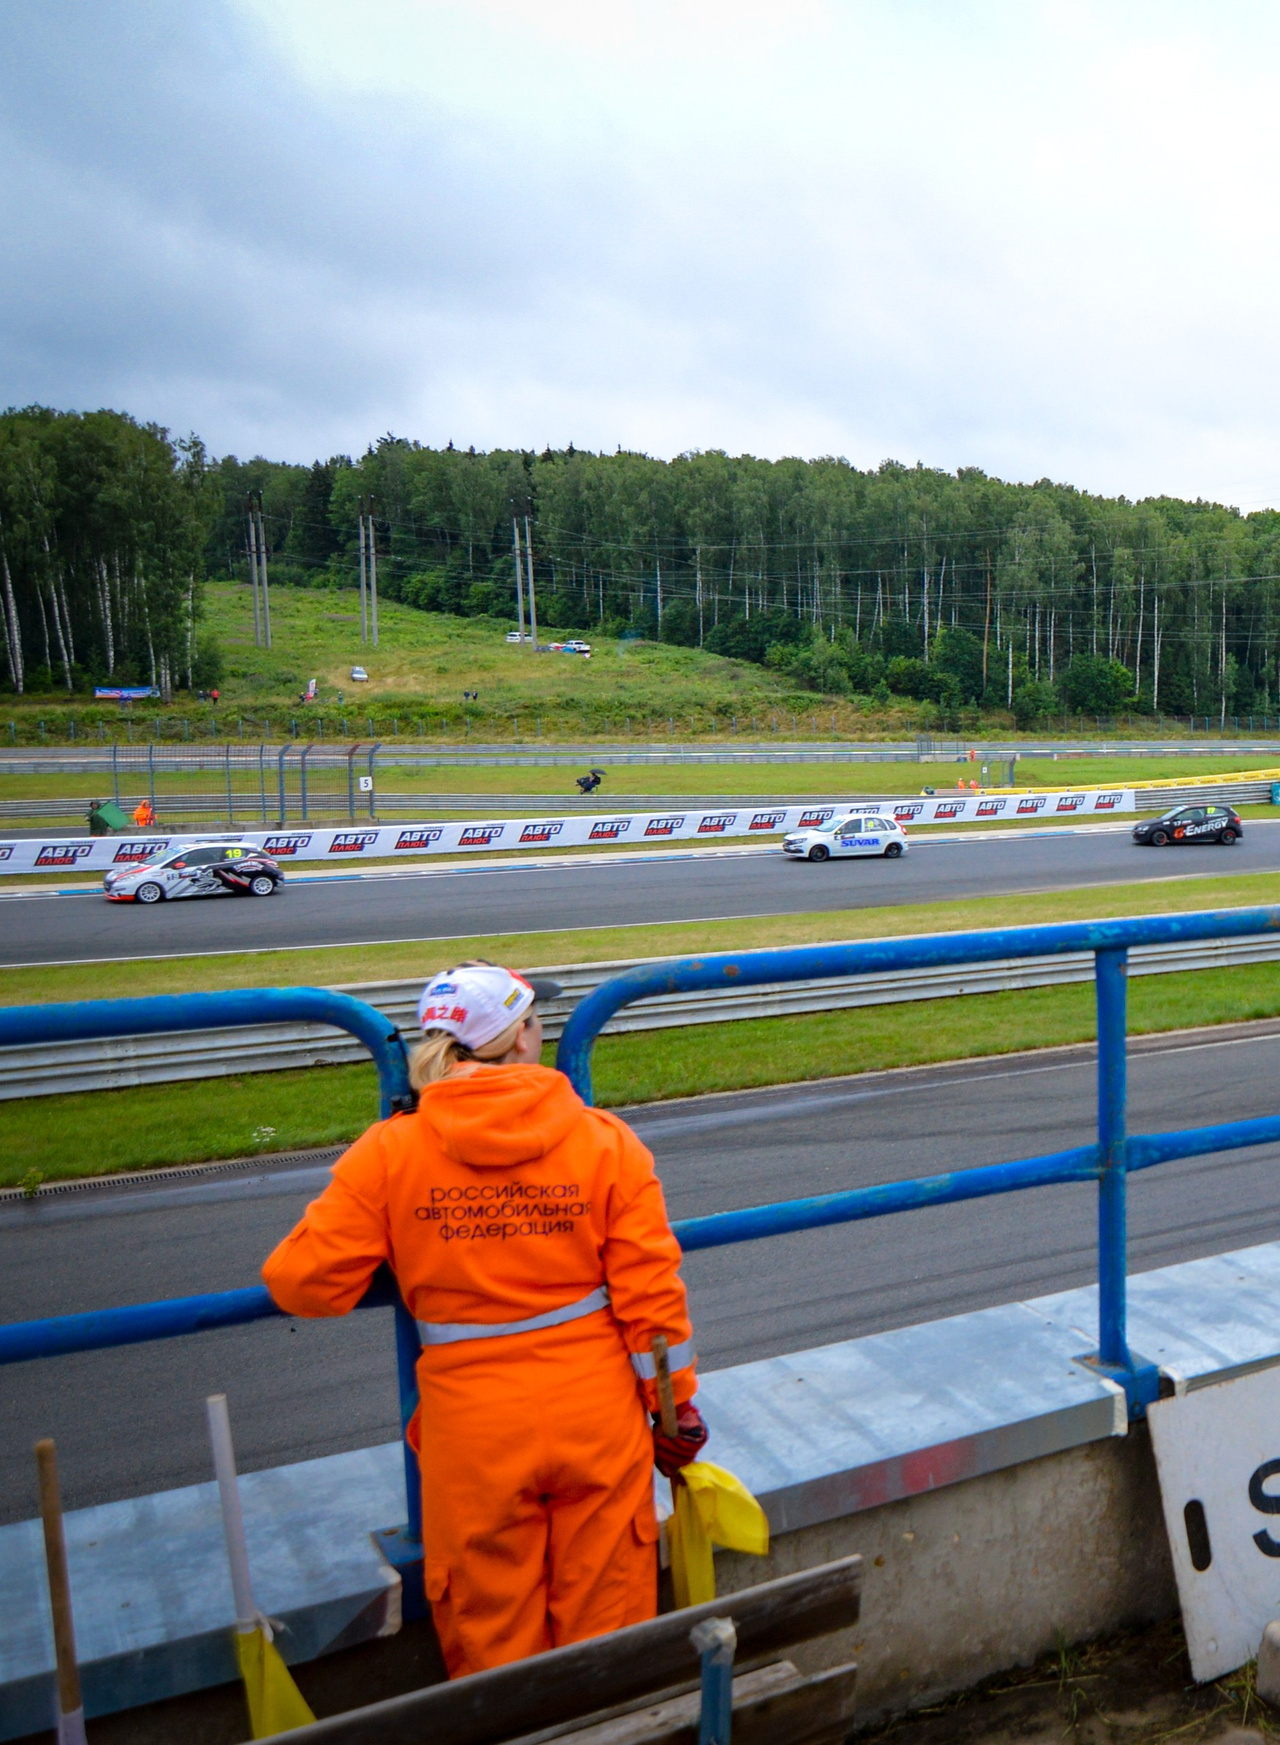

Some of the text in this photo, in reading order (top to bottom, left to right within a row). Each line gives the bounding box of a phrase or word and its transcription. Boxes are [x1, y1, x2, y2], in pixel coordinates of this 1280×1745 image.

[363, 779, 369, 788] 5
[701, 816, 735, 825] АВТО
[752, 813, 785, 823] АВТО
[801, 811, 832, 820] АВТО
[593, 822, 629, 832] АВТО
[648, 818, 683, 828] АВТО
[462, 827, 502, 838] АВТО
[523, 824, 561, 835] АВТО
[333, 834, 376, 845] АВТО
[399, 830, 441, 841] АВТО
[460, 837, 488, 845] ПЛЮС
[264, 836, 309, 848] АВТО
[841, 838, 880, 847] SUVAR
[40, 845, 91, 858] АВТО
[118, 843, 167, 855] АВТО
[225, 848, 242, 859] 19
[37, 857, 73, 865] ПЛЮС
[430, 1181, 580, 1204] российская
[439, 1219, 574, 1243] федерация
